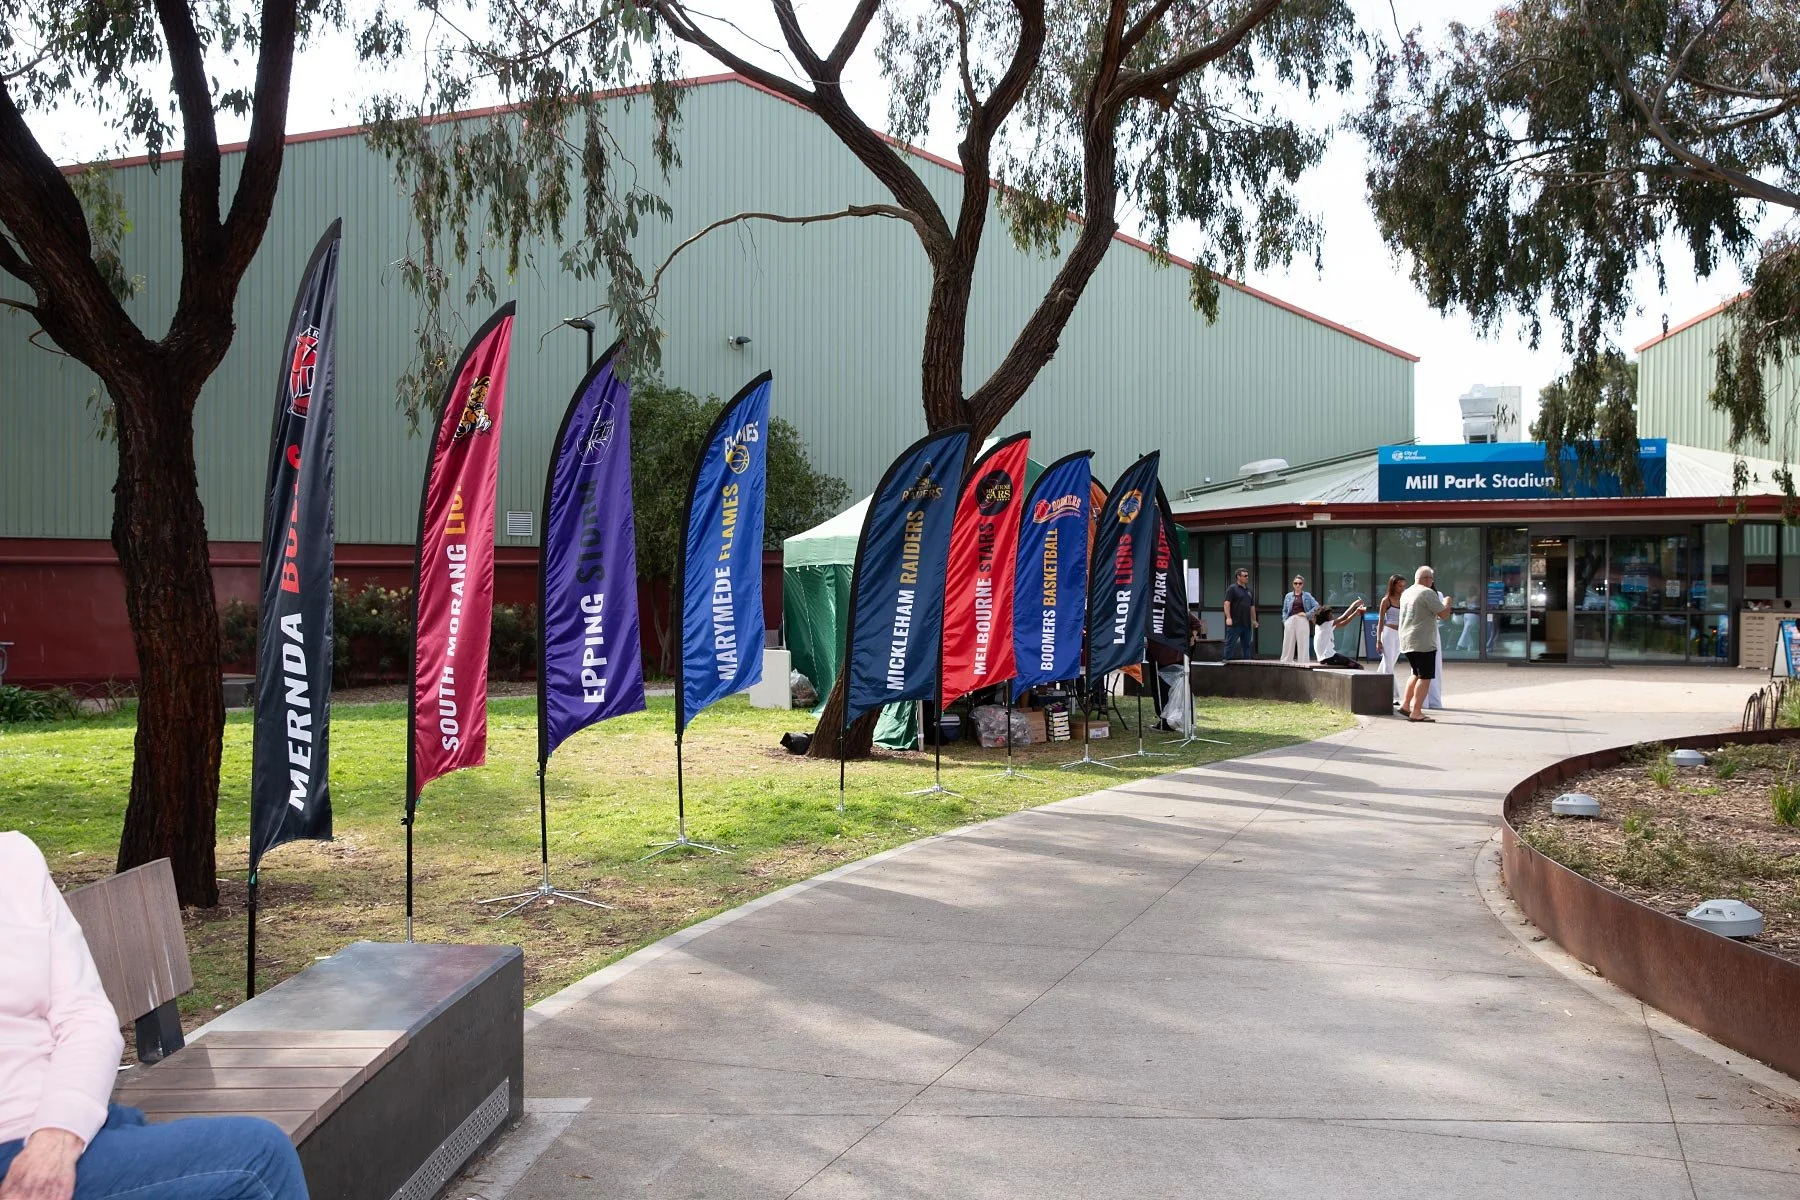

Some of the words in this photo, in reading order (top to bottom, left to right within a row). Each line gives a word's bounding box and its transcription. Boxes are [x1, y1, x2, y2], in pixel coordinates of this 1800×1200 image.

[1405, 475, 1438, 490] Mill
[1444, 474, 1487, 489] Park
[718, 482, 739, 562] FLAMES
[900, 510, 925, 584] RAIDERS
[978, 522, 995, 573] STARS
[1115, 533, 1133, 585] LIONS
[446, 544, 467, 657] MORANG
[1043, 528, 1058, 607] BASKETBALL
[1153, 571, 1168, 604] PARK
[580, 593, 608, 704] EPPING
[712, 566, 738, 681] MARYMEDE
[886, 590, 915, 691] MICKLEHAM
[974, 577, 993, 675] MELBOURNE
[1040, 609, 1056, 671] BOOMERS
[1113, 590, 1132, 645] LALOR
[1152, 608, 1165, 634] MILL
[280, 612, 312, 812] MERNDA
[438, 665, 461, 752] SOUTH
